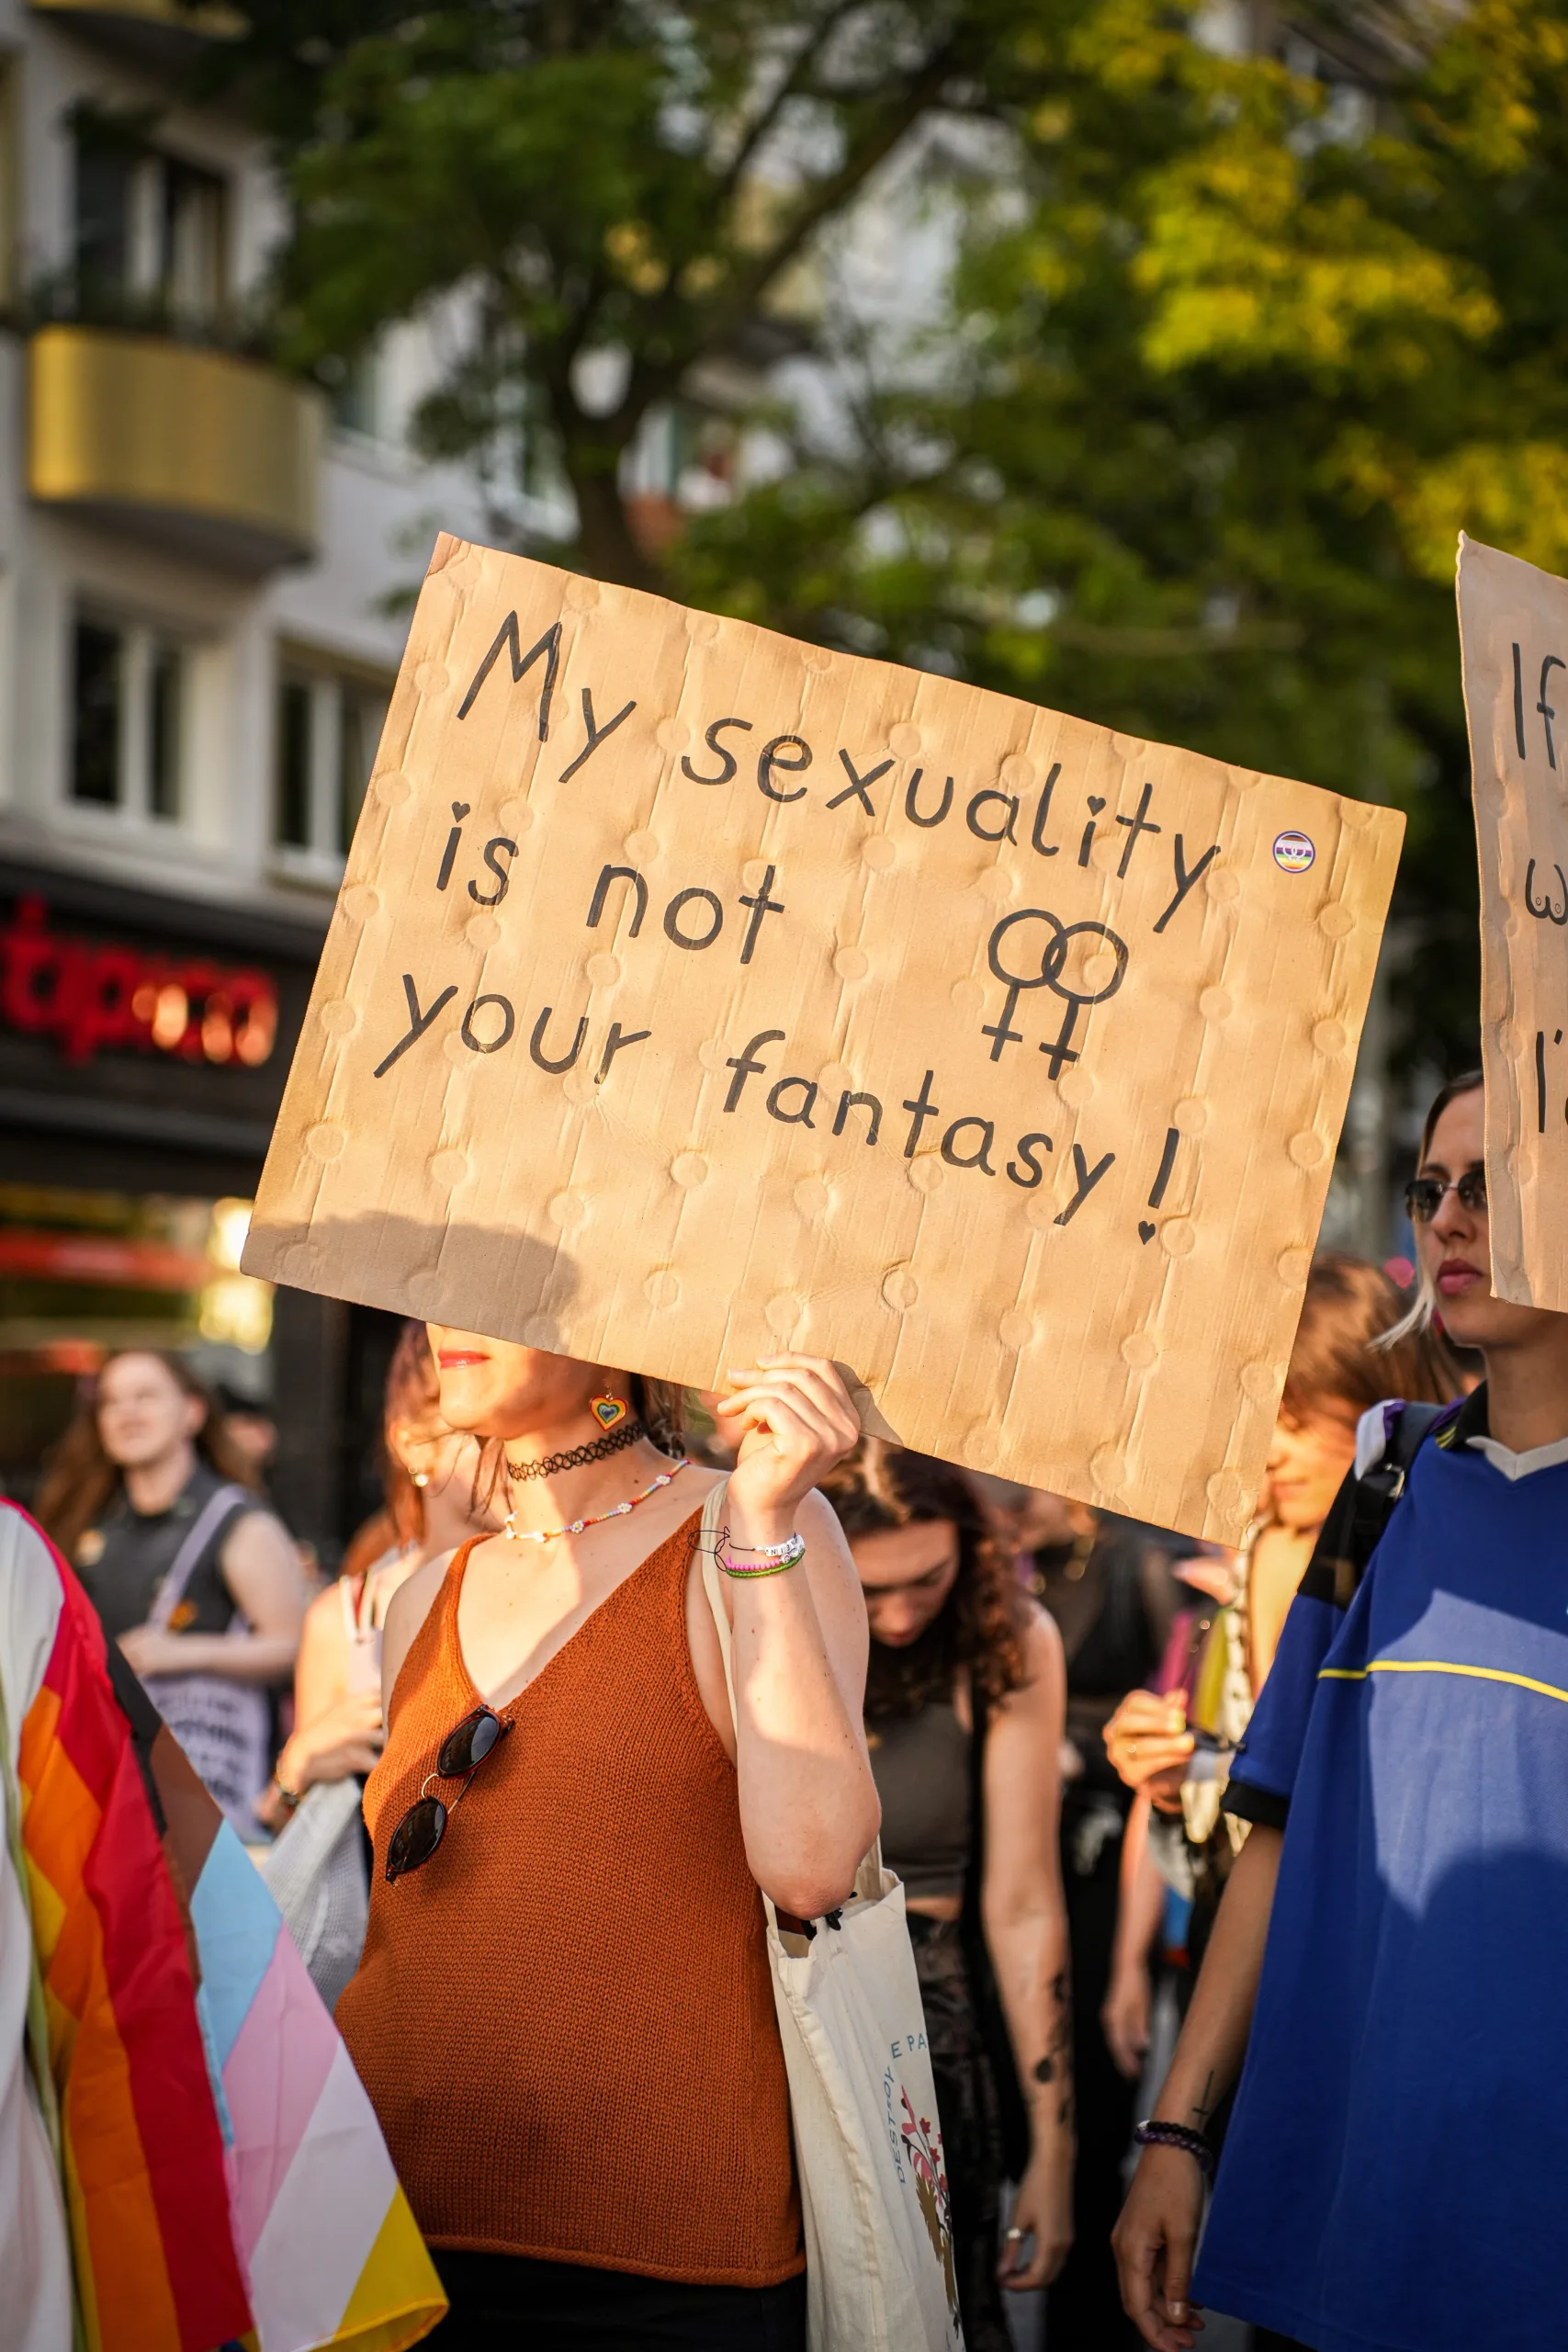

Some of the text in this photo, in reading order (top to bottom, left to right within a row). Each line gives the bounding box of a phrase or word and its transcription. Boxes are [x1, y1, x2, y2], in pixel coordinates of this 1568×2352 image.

[457, 610, 1222, 933] My sexuality
[1512, 642, 1567, 772] If
[436, 801, 785, 965] is not
[373, 974, 652, 1084] your
